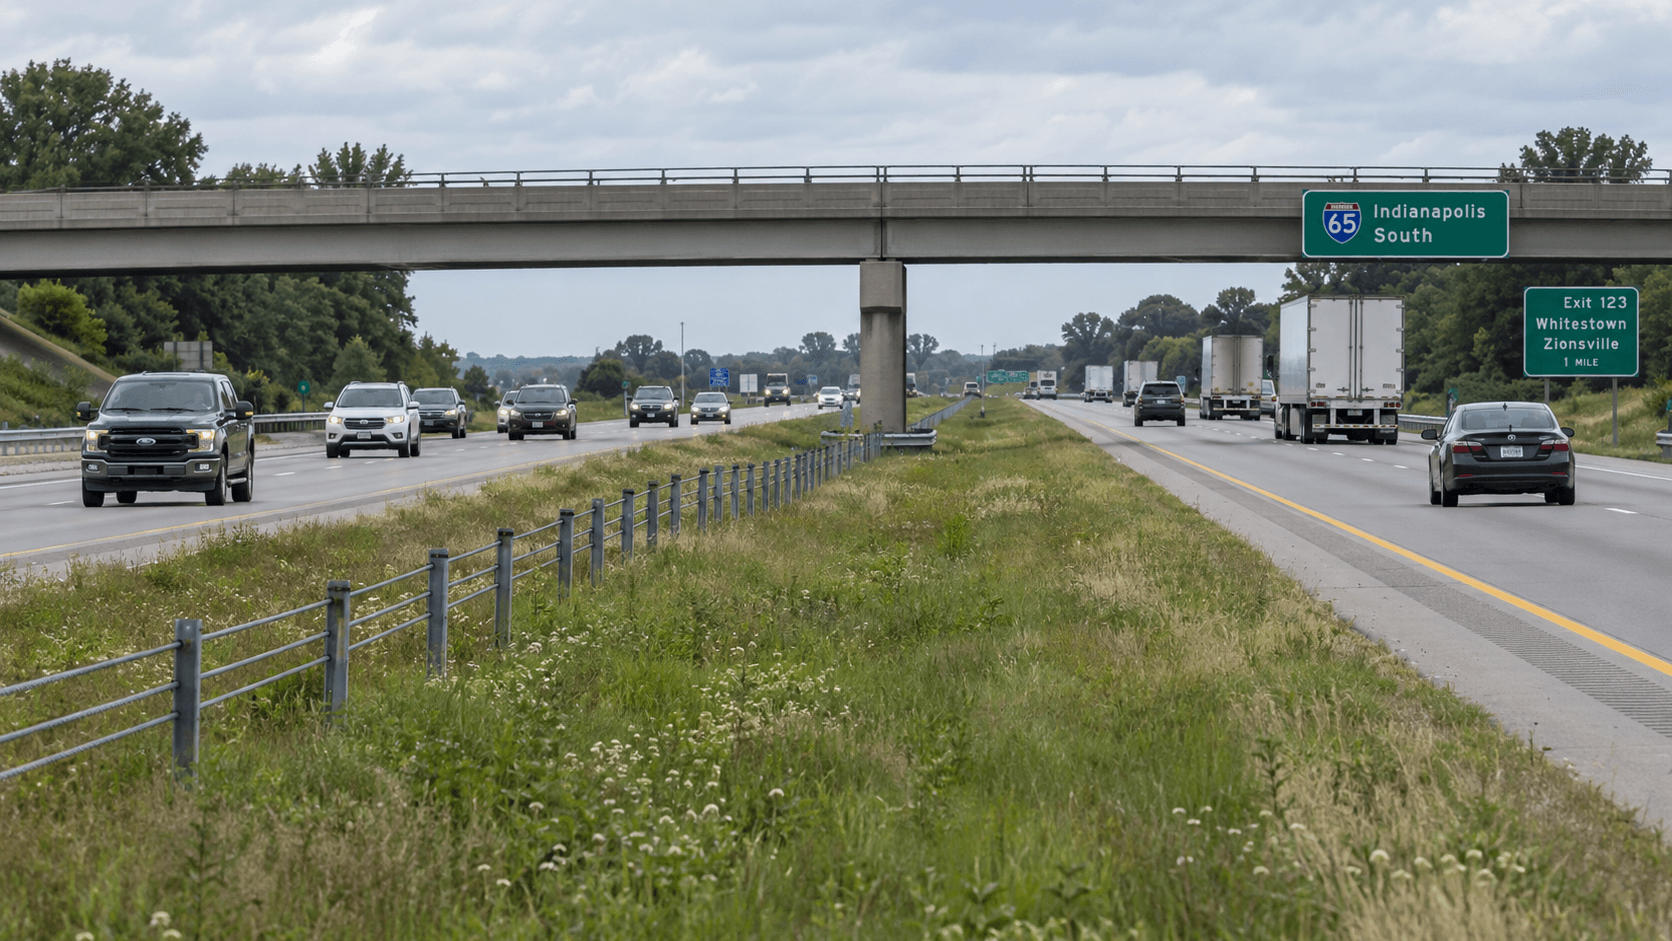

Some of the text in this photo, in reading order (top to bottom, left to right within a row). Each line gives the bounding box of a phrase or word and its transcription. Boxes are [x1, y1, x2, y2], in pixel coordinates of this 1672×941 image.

[1374, 204, 1486, 221] Indianapolis
[1328, 213, 1357, 234] 65
[1374, 227, 1433, 243] South
[1564, 296, 1627, 309] Exit 123
[1536, 317, 1627, 330] Whitestown
[1543, 337, 1619, 350] Zionsville
[1563, 357, 1599, 367] 1 MILE
